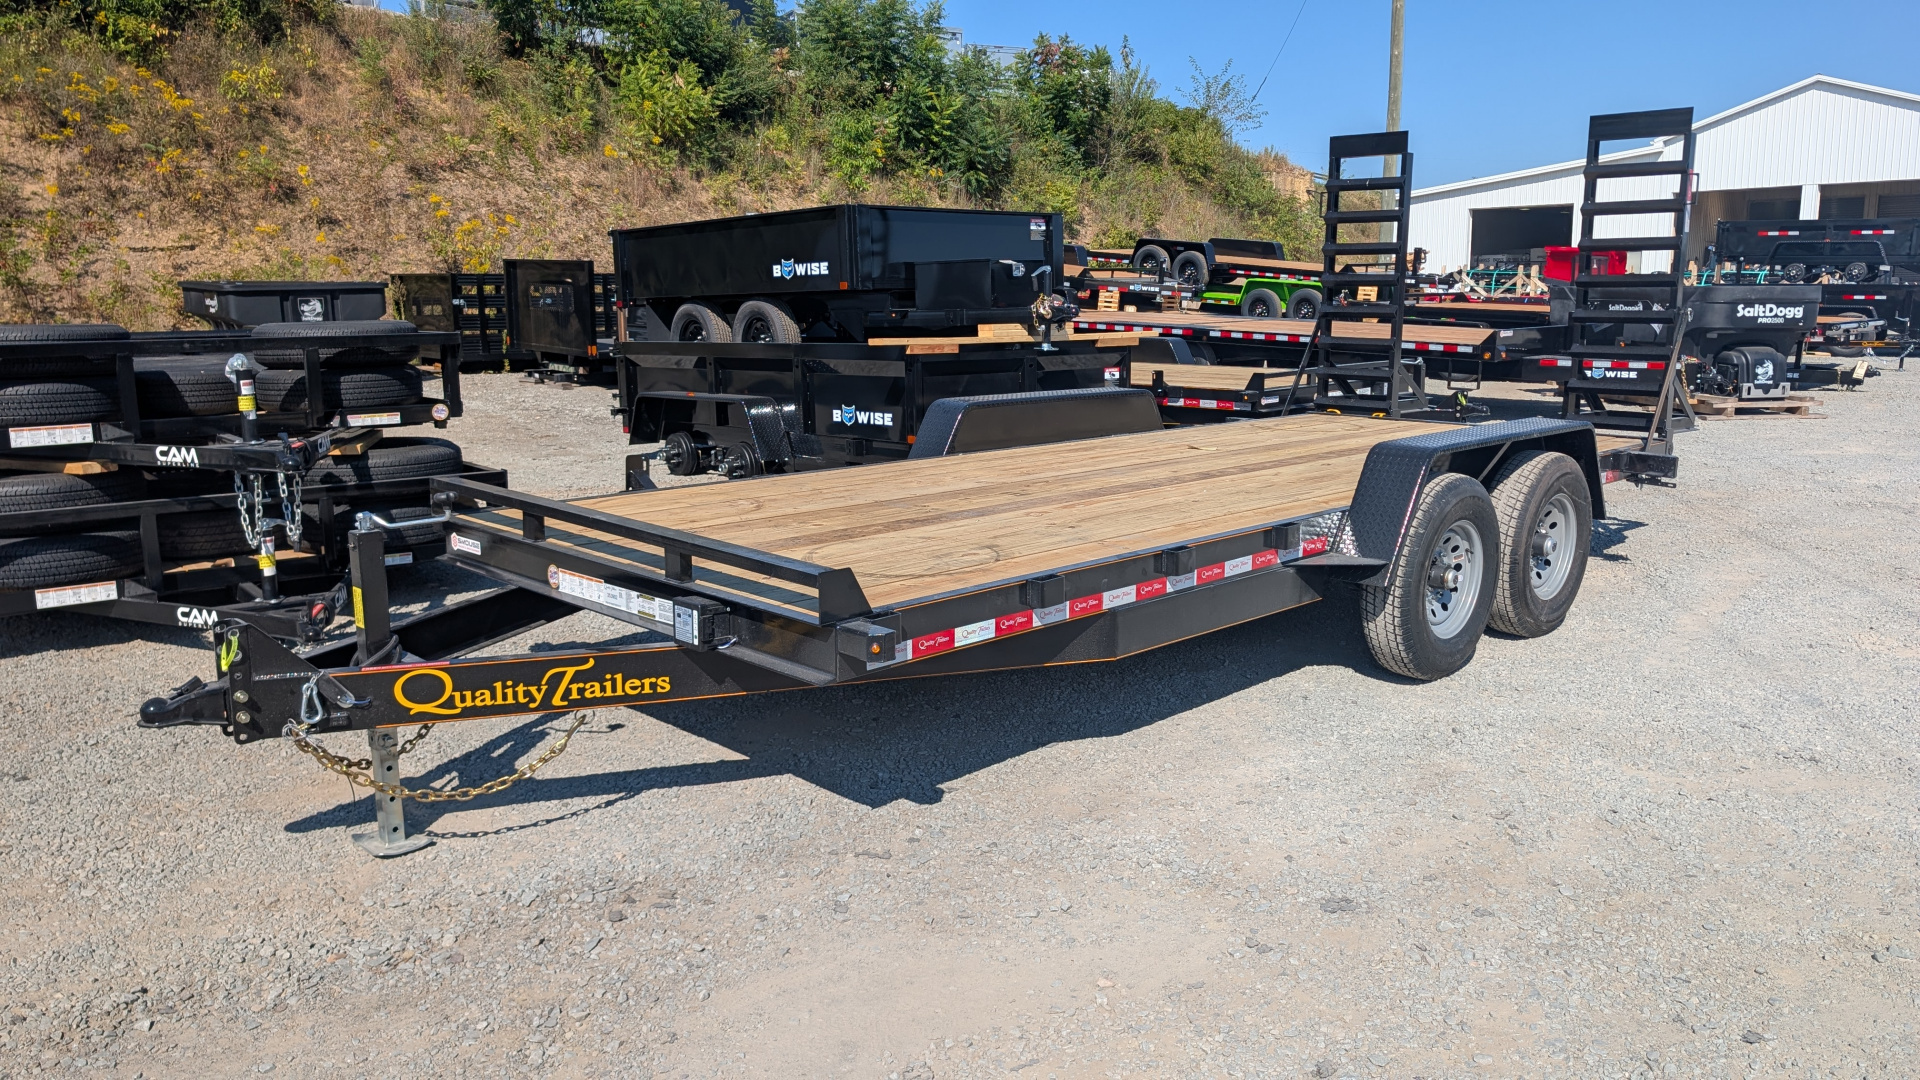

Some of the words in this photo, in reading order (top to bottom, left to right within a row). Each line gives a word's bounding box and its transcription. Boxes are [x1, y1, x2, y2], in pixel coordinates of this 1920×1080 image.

[1736, 303, 1805, 319] SaltDogg
[155, 445, 199, 463] CAM
[157, 460, 200, 468] SUPERLINE
[176, 606, 219, 626] CAM
[918, 639, 936, 650] Quality
[393, 668, 548, 716] Quality
[541, 657, 671, 707] Trailers
